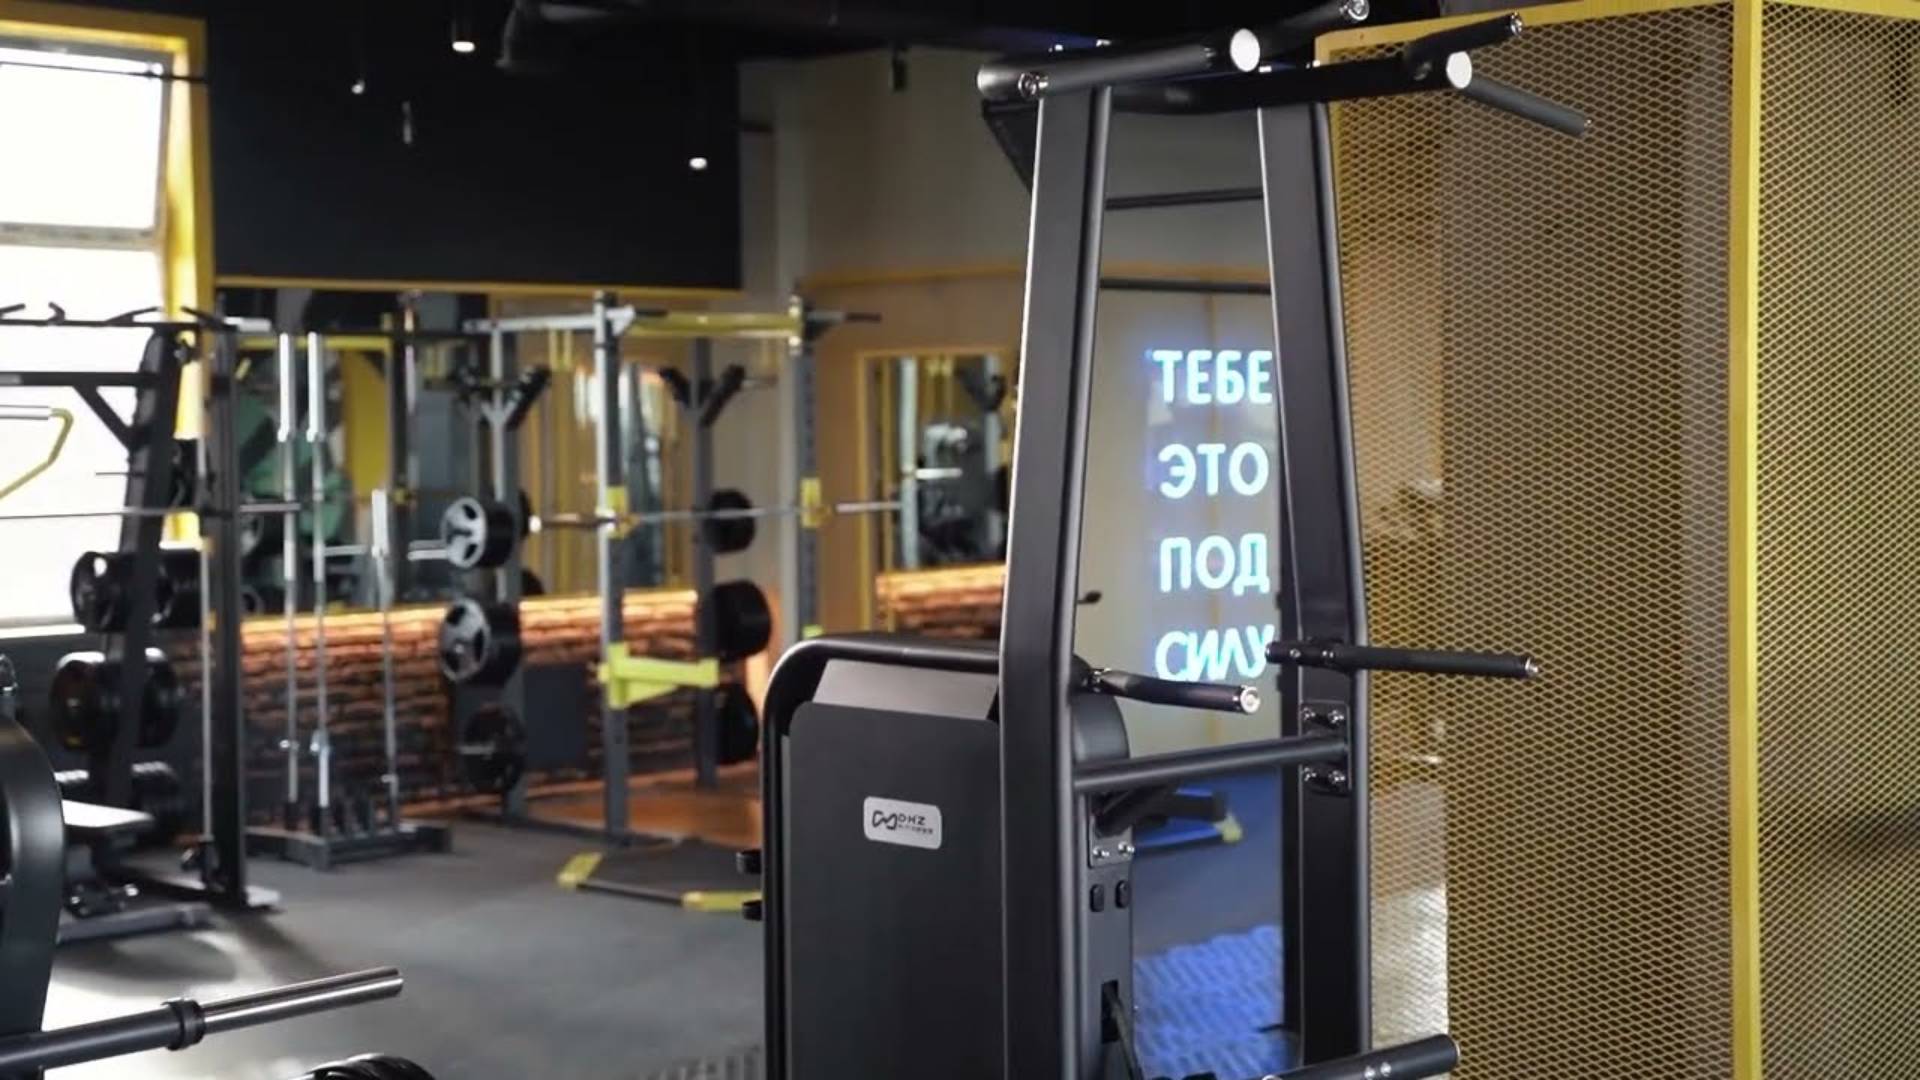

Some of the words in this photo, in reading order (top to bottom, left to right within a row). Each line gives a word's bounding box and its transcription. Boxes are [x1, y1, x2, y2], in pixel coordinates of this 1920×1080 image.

[1153, 349, 1273, 405] ТЕБЕ
[1158, 441, 1270, 499] ЭТО
[1159, 532, 1270, 597] ПОД
[1154, 624, 1275, 683] СИЛУ
